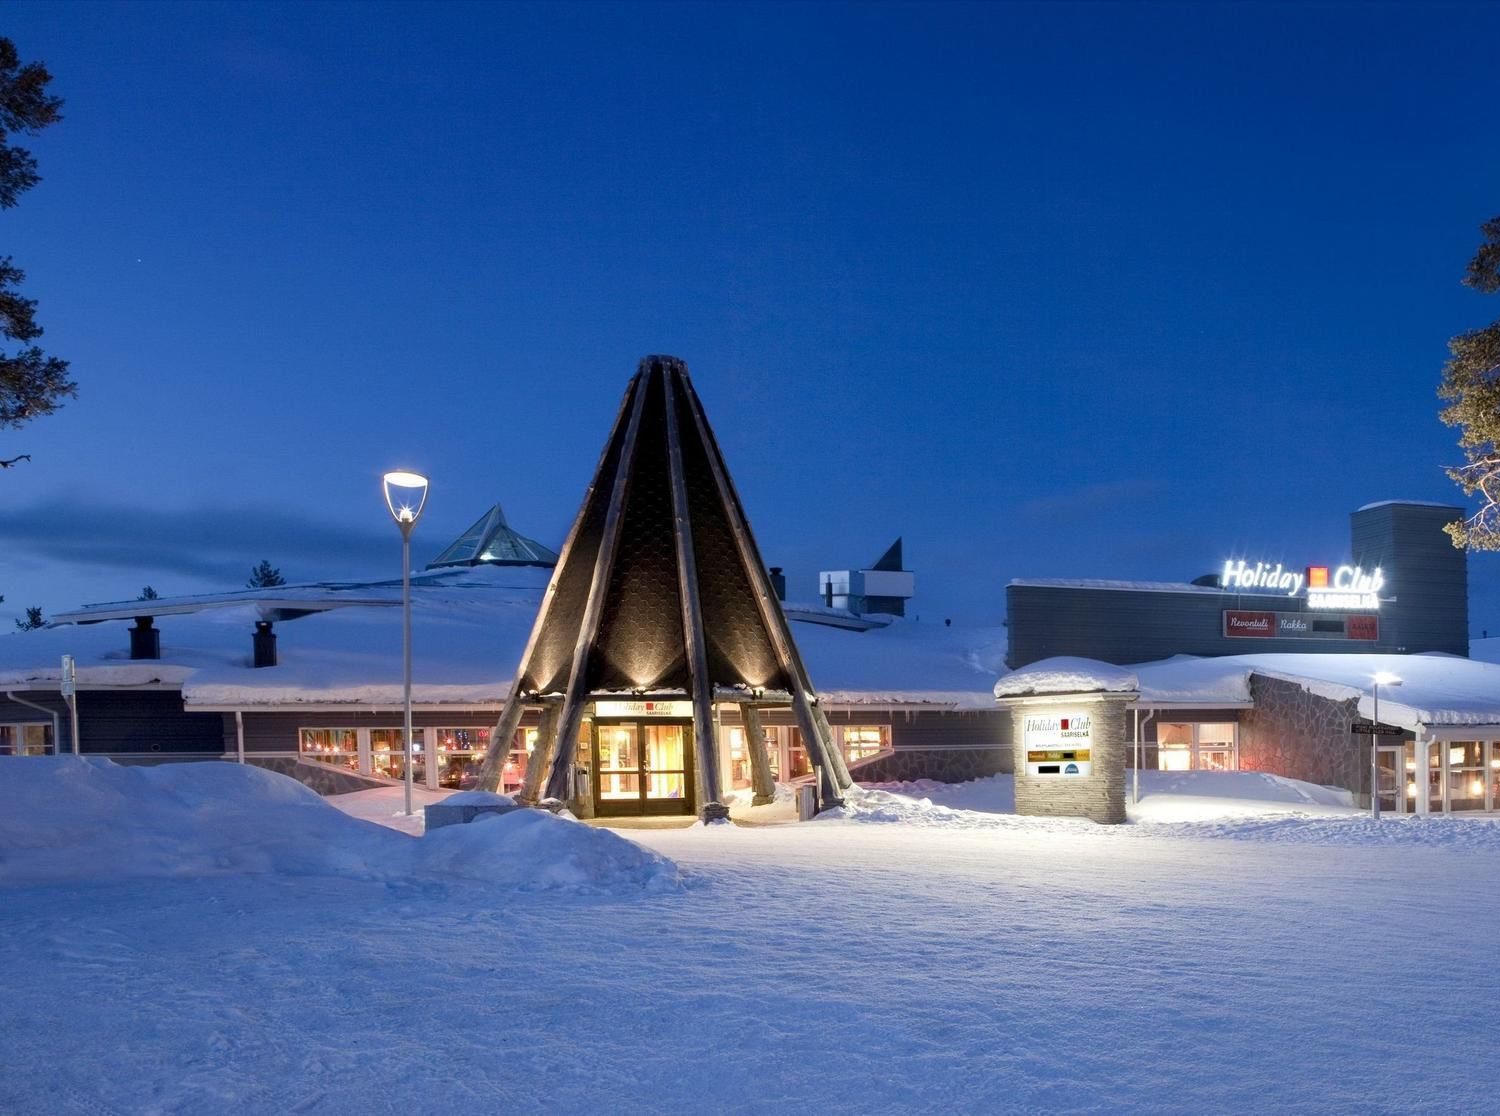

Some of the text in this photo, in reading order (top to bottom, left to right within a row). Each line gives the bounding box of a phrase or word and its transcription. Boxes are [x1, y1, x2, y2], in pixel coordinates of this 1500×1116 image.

[1221, 560, 1384, 596] Holiday Club
[1230, 617, 1269, 627] Revontuli
[1280, 619, 1307, 630] Rakka
[655, 702, 674, 711] Club
[1070, 717, 1091, 730] Club
